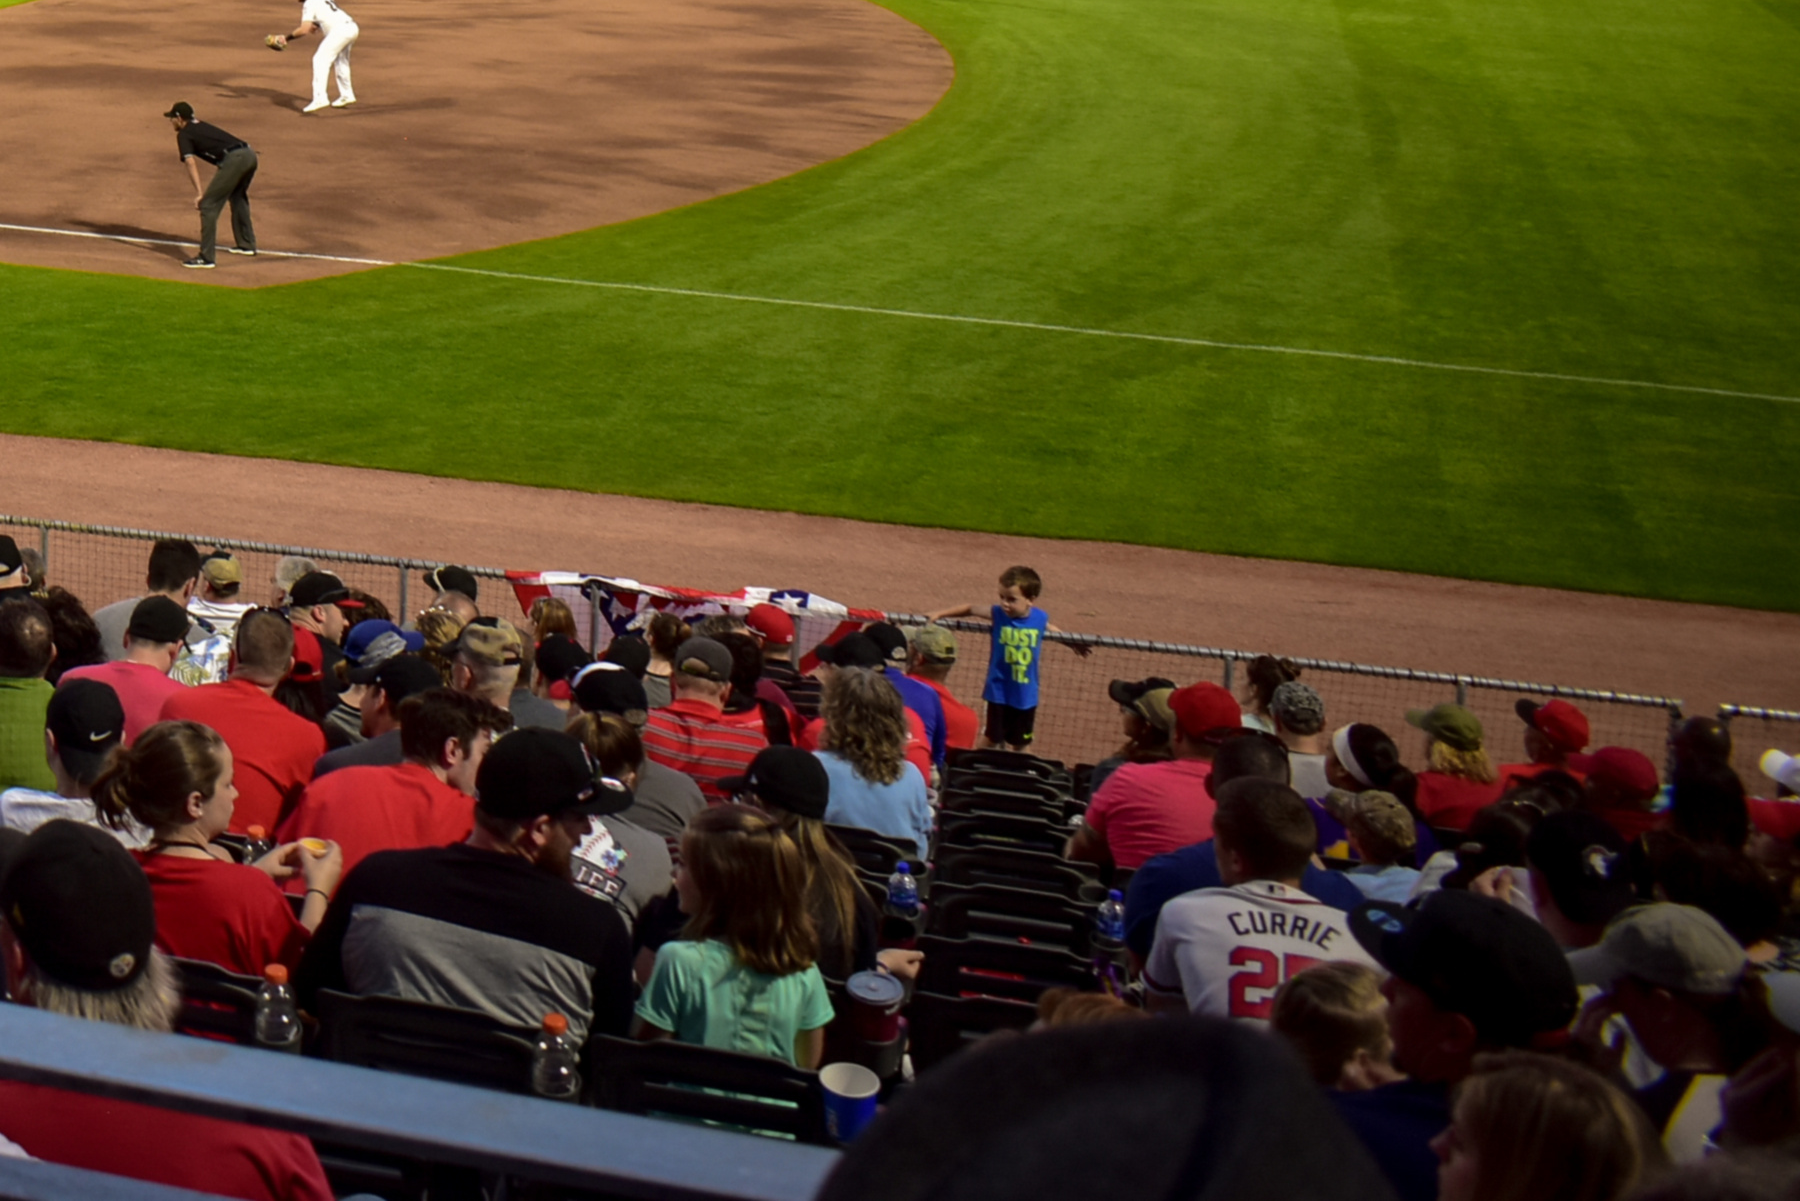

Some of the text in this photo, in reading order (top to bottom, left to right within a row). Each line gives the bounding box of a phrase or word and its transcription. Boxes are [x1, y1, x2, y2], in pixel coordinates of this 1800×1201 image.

[999, 626, 1039, 647] JUST
[1005, 645, 1032, 666] DO
[1227, 910, 1342, 952] CURRIE
